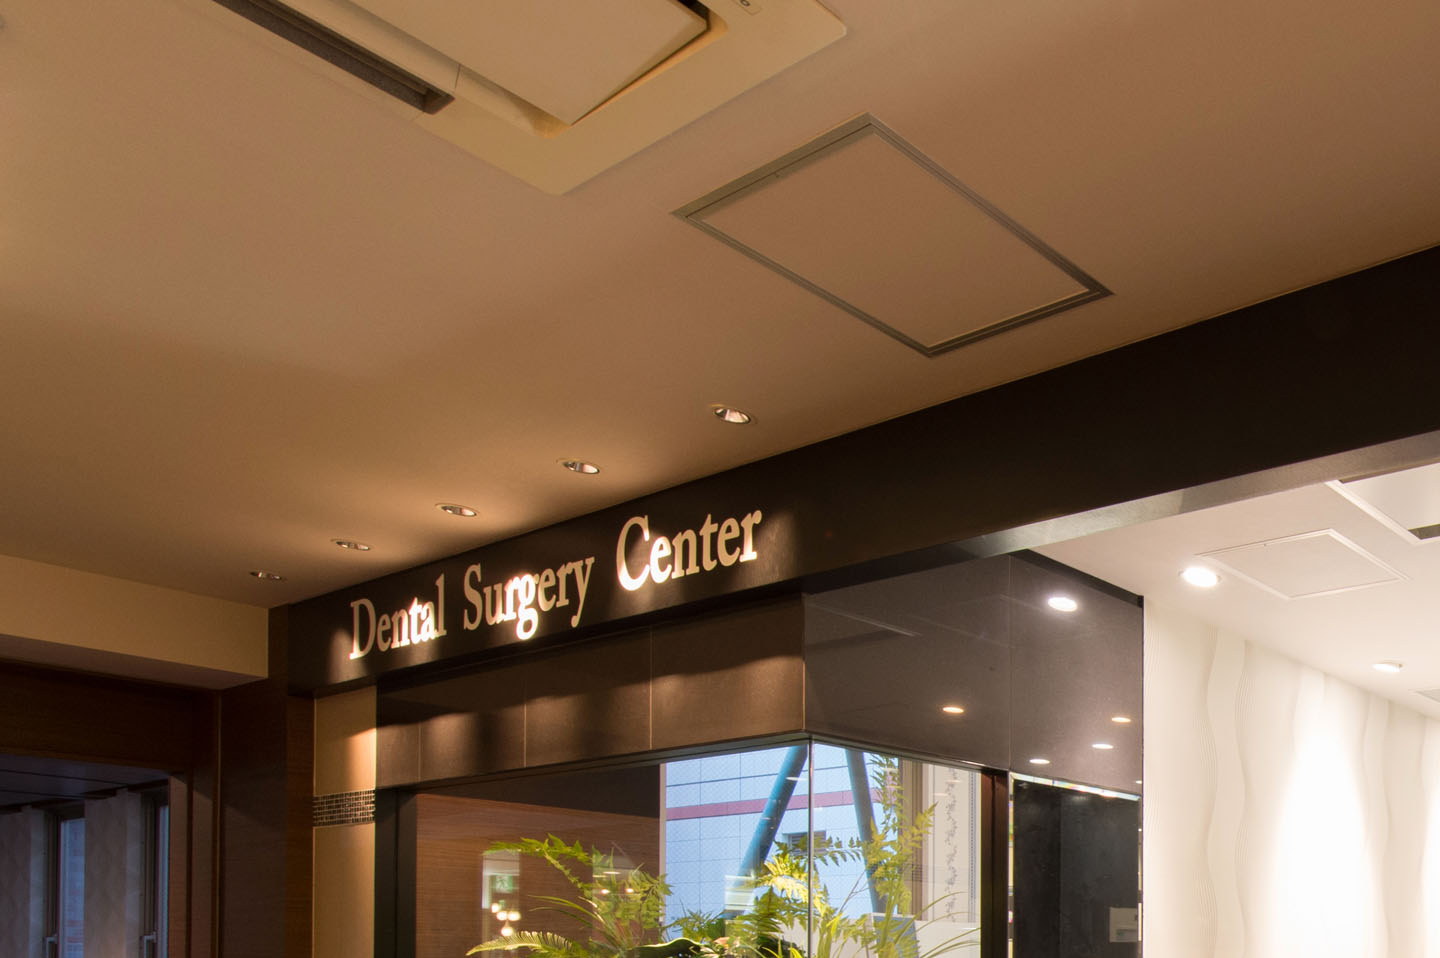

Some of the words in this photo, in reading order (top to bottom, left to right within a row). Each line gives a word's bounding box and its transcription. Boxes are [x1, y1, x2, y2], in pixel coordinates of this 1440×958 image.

[349, 574, 447, 660] Dental
[463, 555, 596, 640] Surgery
[614, 509, 763, 591] Center
